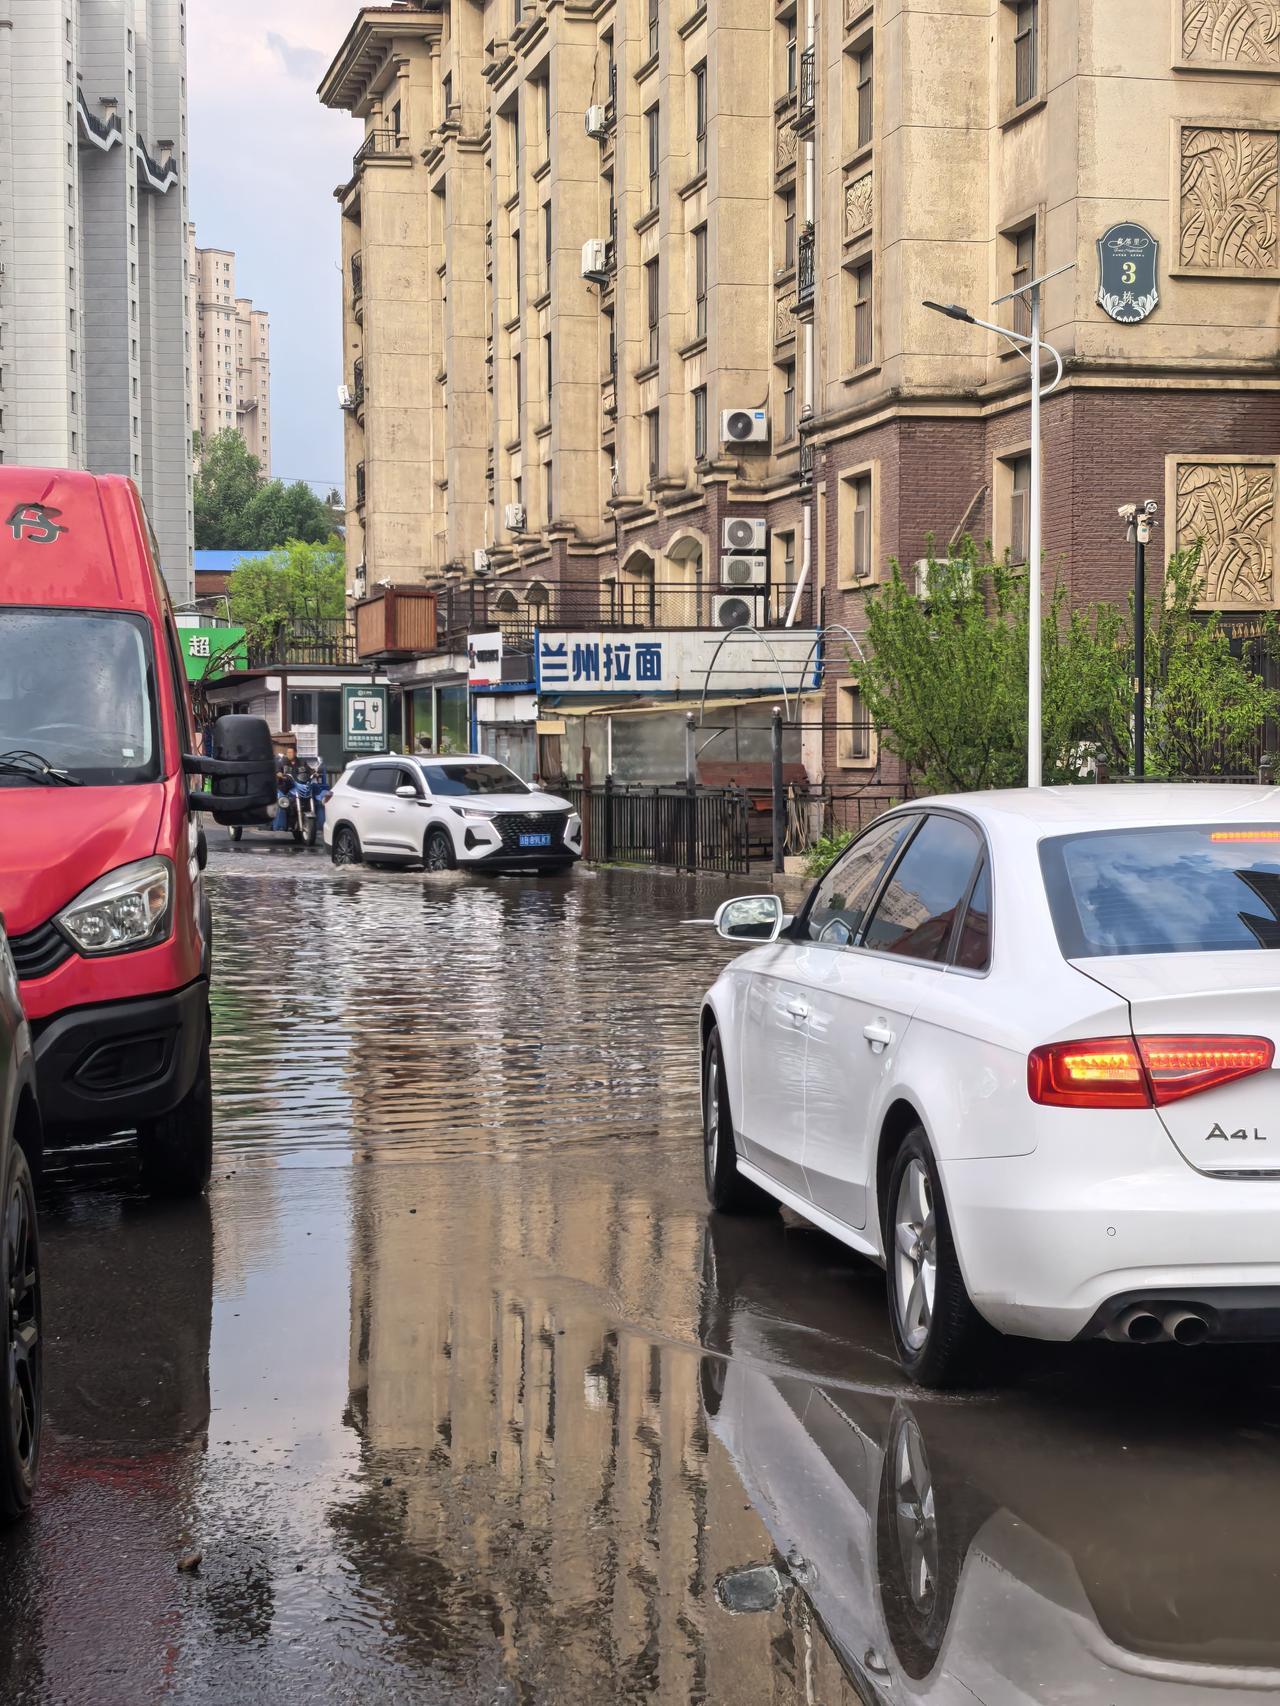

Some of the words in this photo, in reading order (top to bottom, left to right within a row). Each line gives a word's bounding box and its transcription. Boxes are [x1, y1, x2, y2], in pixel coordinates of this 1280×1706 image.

[1121, 262, 1137, 284] 3
[1122, 291, 1135, 304] 栋
[540, 642, 662, 682] 兰州拉面
